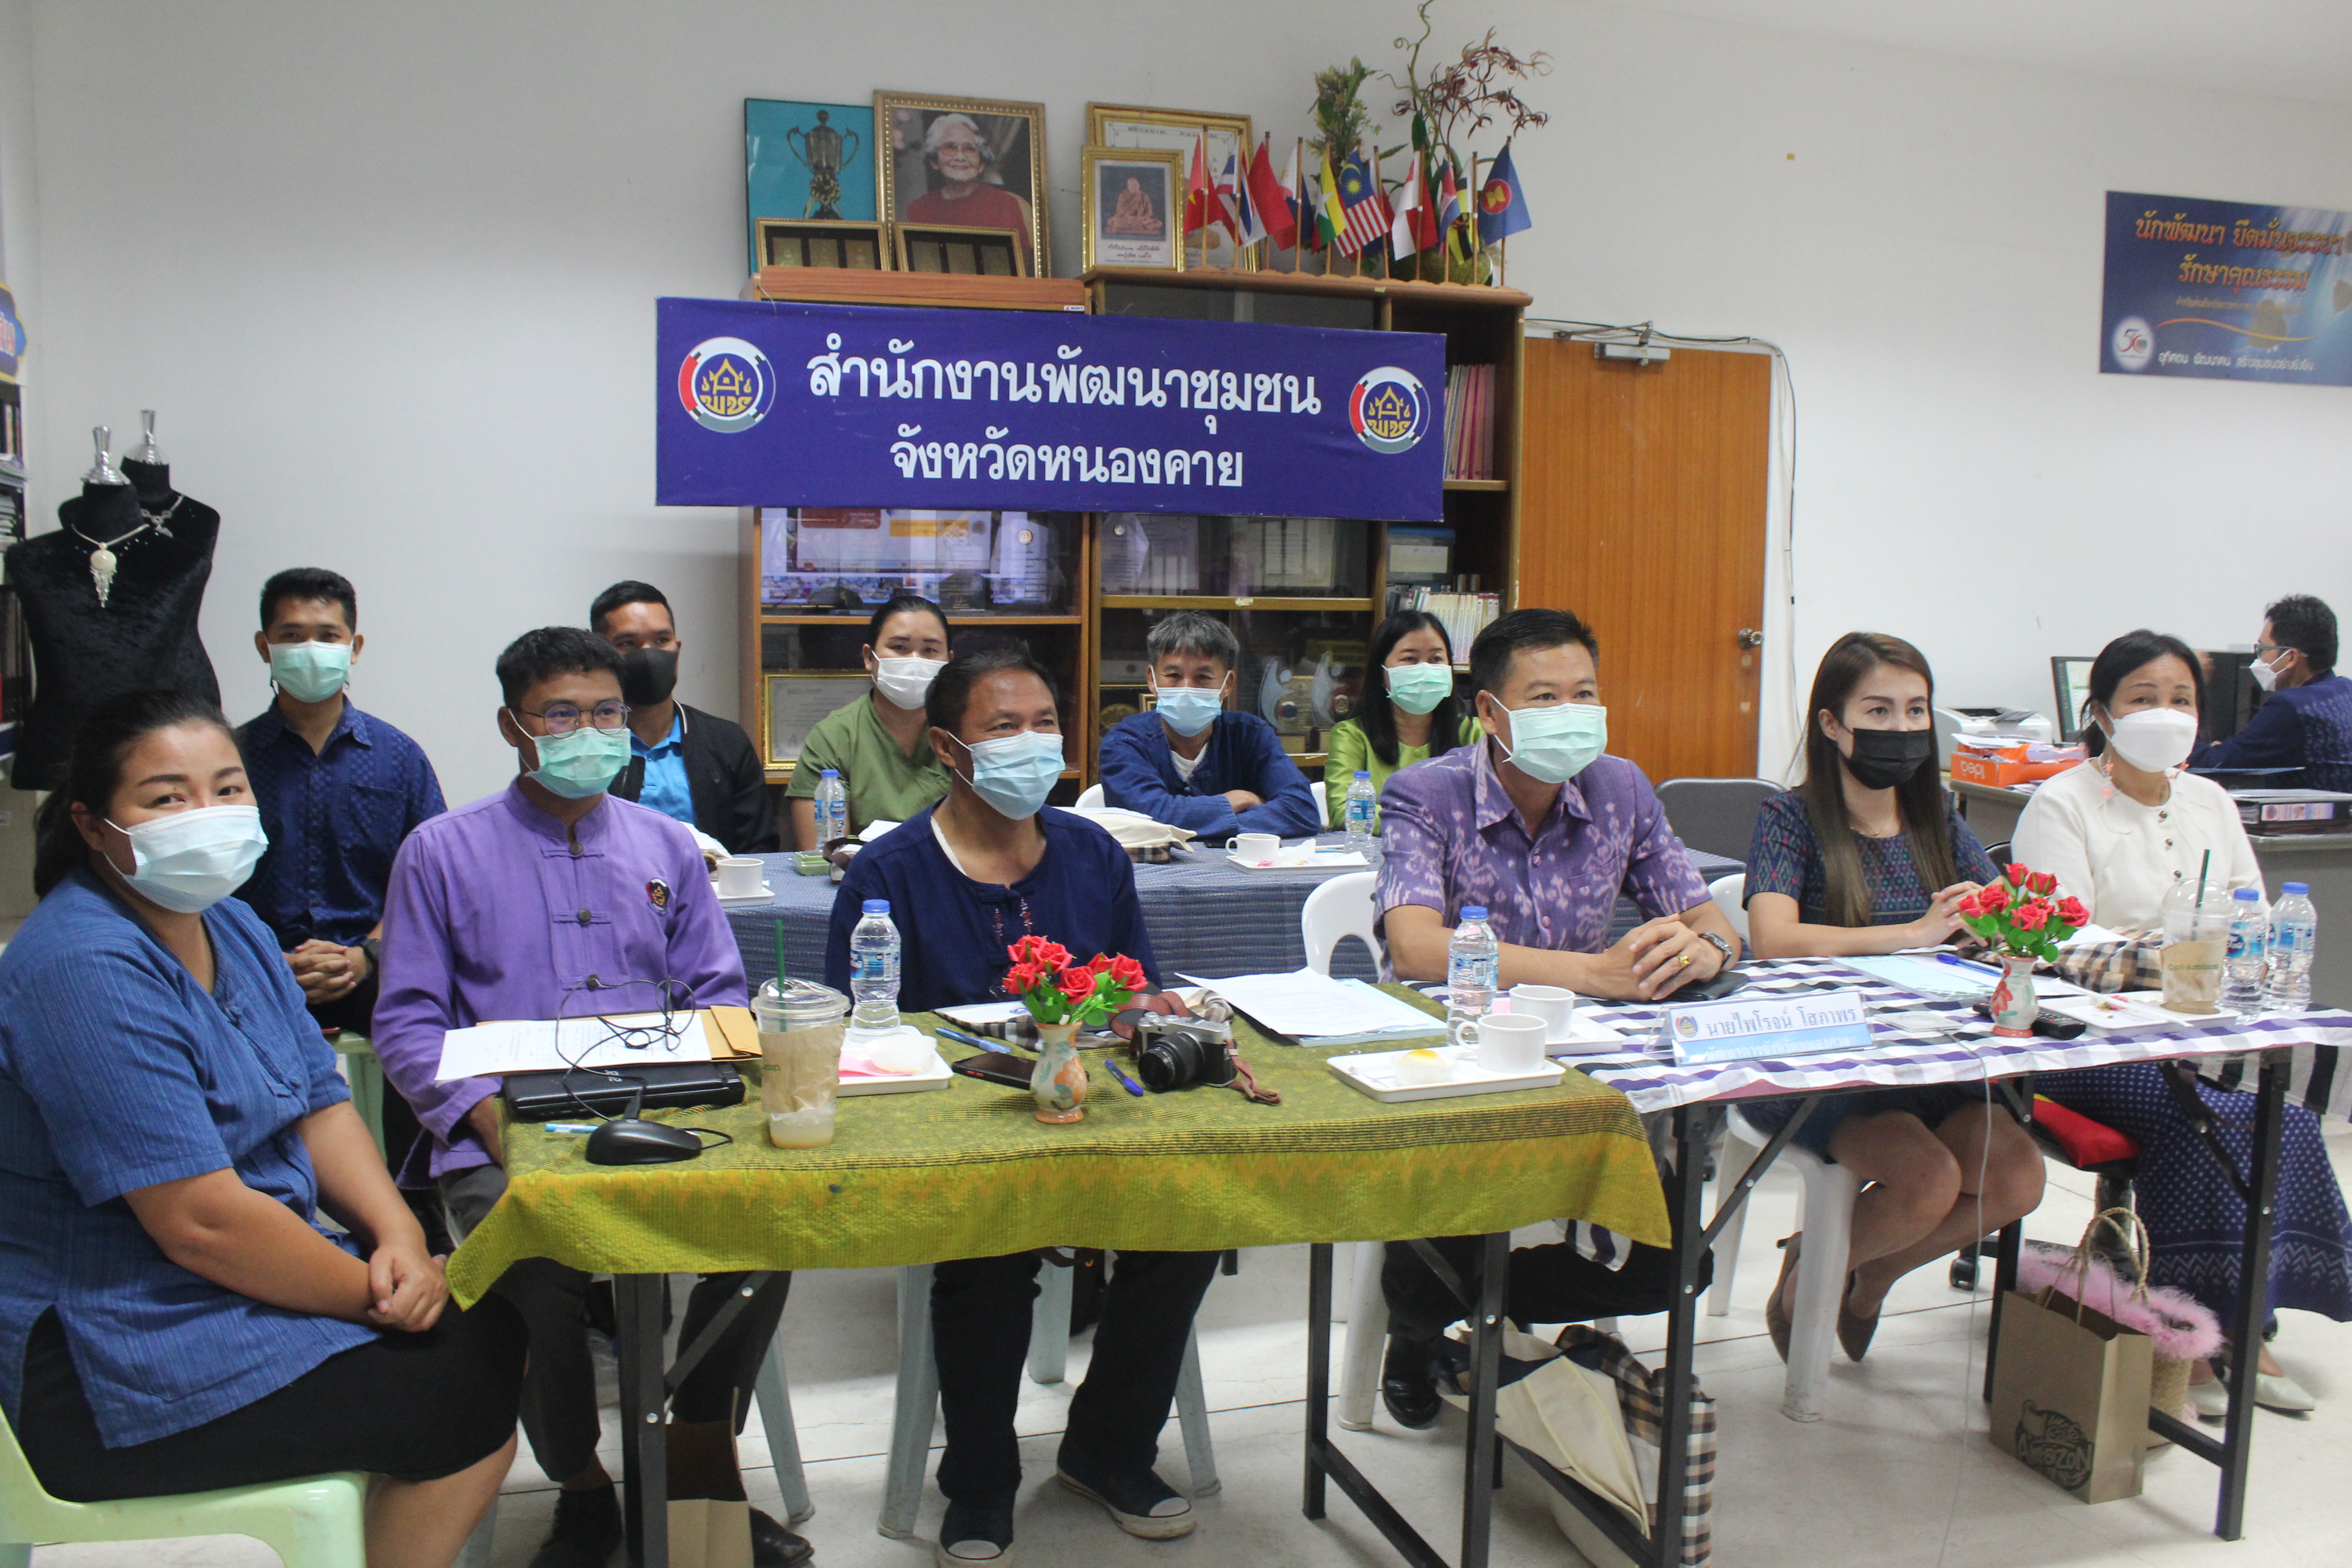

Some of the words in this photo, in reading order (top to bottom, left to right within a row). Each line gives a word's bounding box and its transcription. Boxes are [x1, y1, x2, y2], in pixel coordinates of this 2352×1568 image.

[2135, 210, 2226, 245] นักพัฒนา
[2177, 253, 2311, 294] รักษาคุณธรรม
[807, 332, 1322, 435] สำนักงานพัฒนาชุมชน
[890, 423, 1243, 487] จังหวัดหนองคาย
[1705, 1008, 1793, 1037] นายไพโรจน์
[1796, 1006, 1857, 1026] โสภาพร
